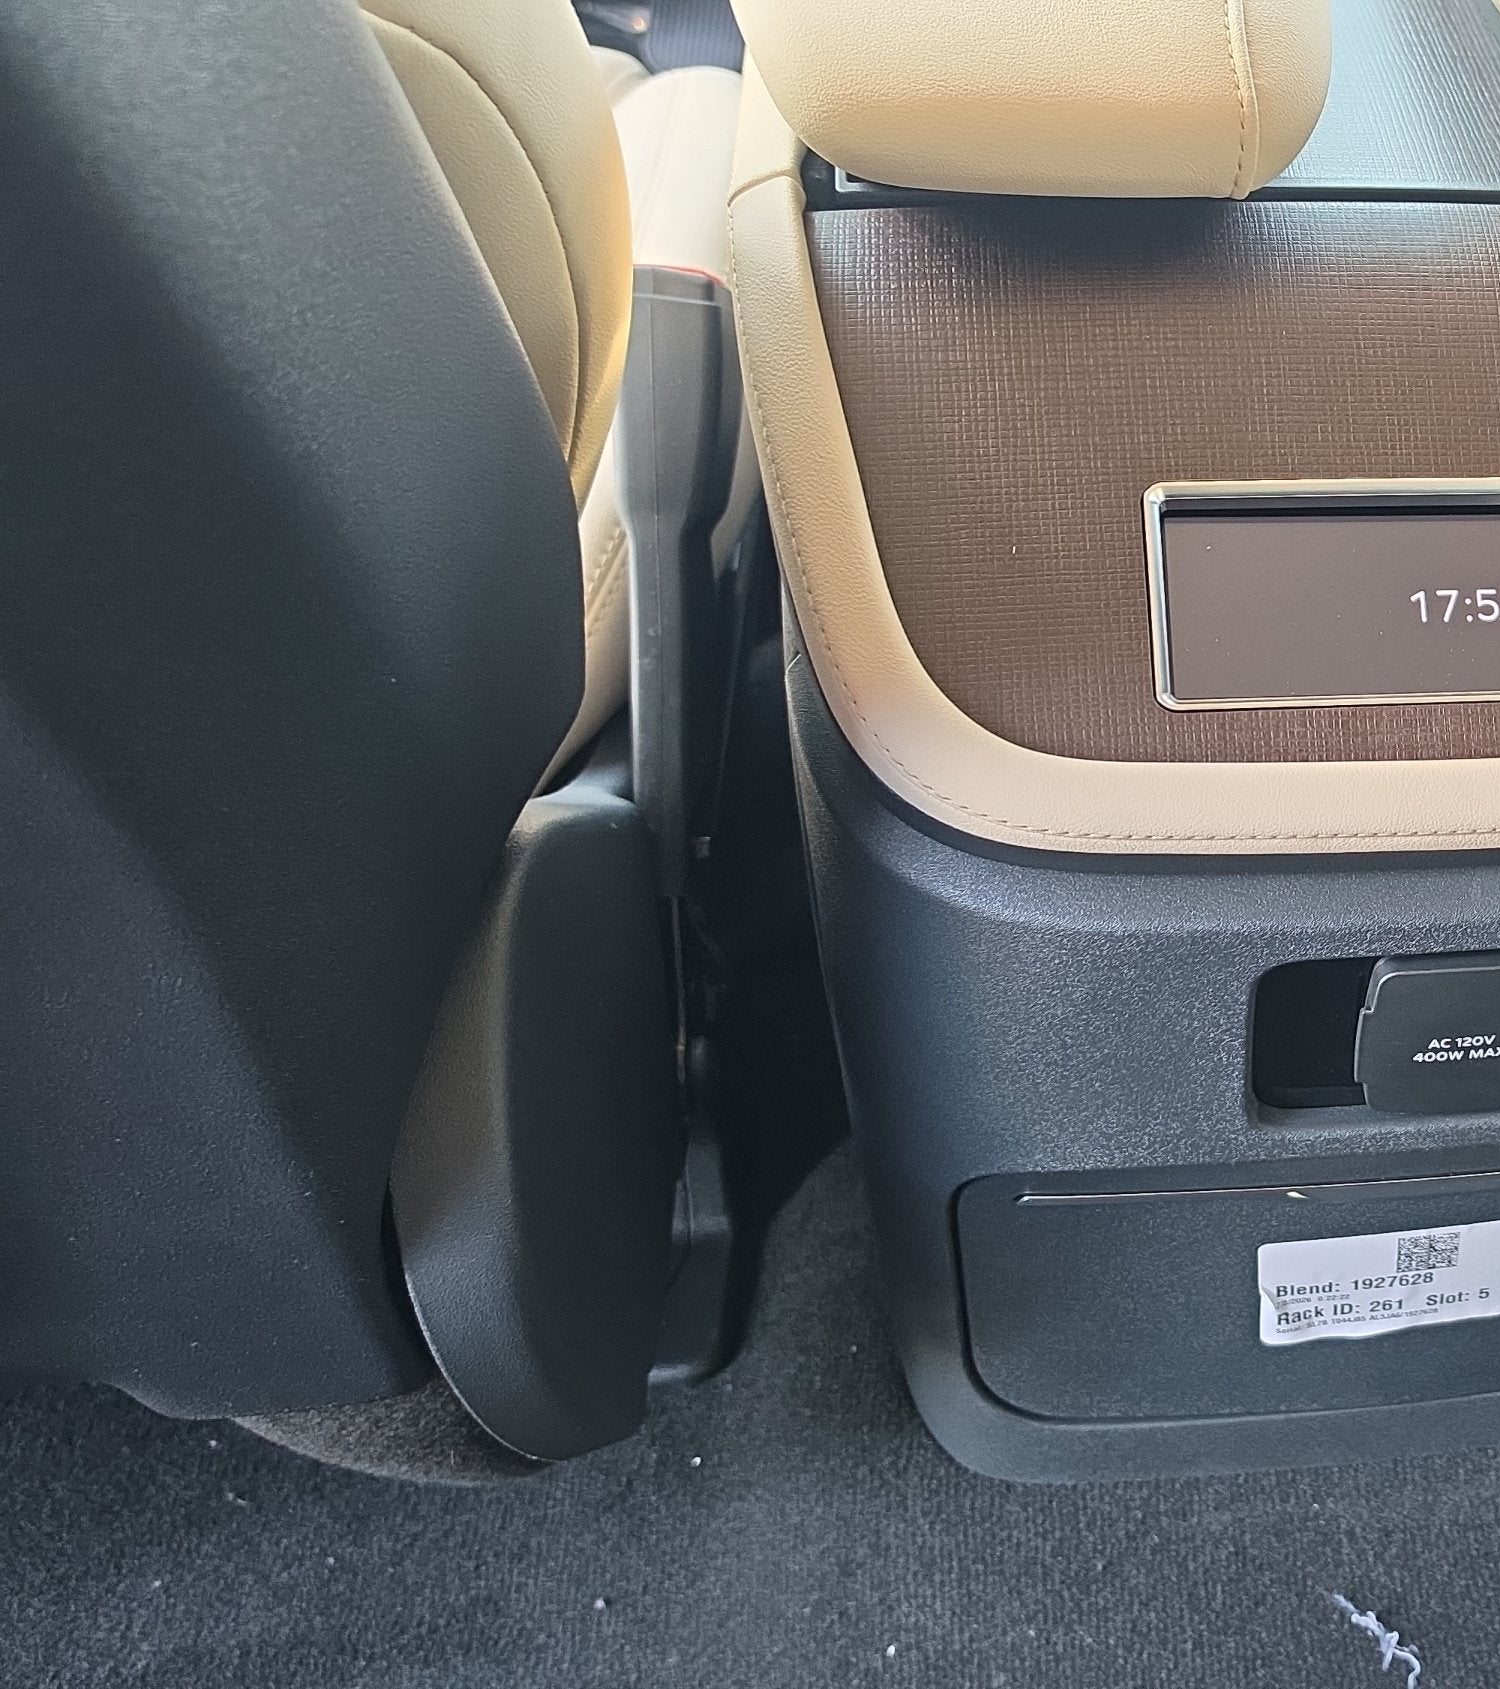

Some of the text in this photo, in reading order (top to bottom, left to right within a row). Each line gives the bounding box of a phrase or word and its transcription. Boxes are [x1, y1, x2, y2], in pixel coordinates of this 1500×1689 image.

[1427, 1035, 1496, 1050] AC 120V
[1412, 1050, 1464, 1063] 400W
[1275, 1271, 1434, 1298] Blend: 1927628
[1276, 1287, 1491, 1326] Rack ID: 261 Slot: 5
